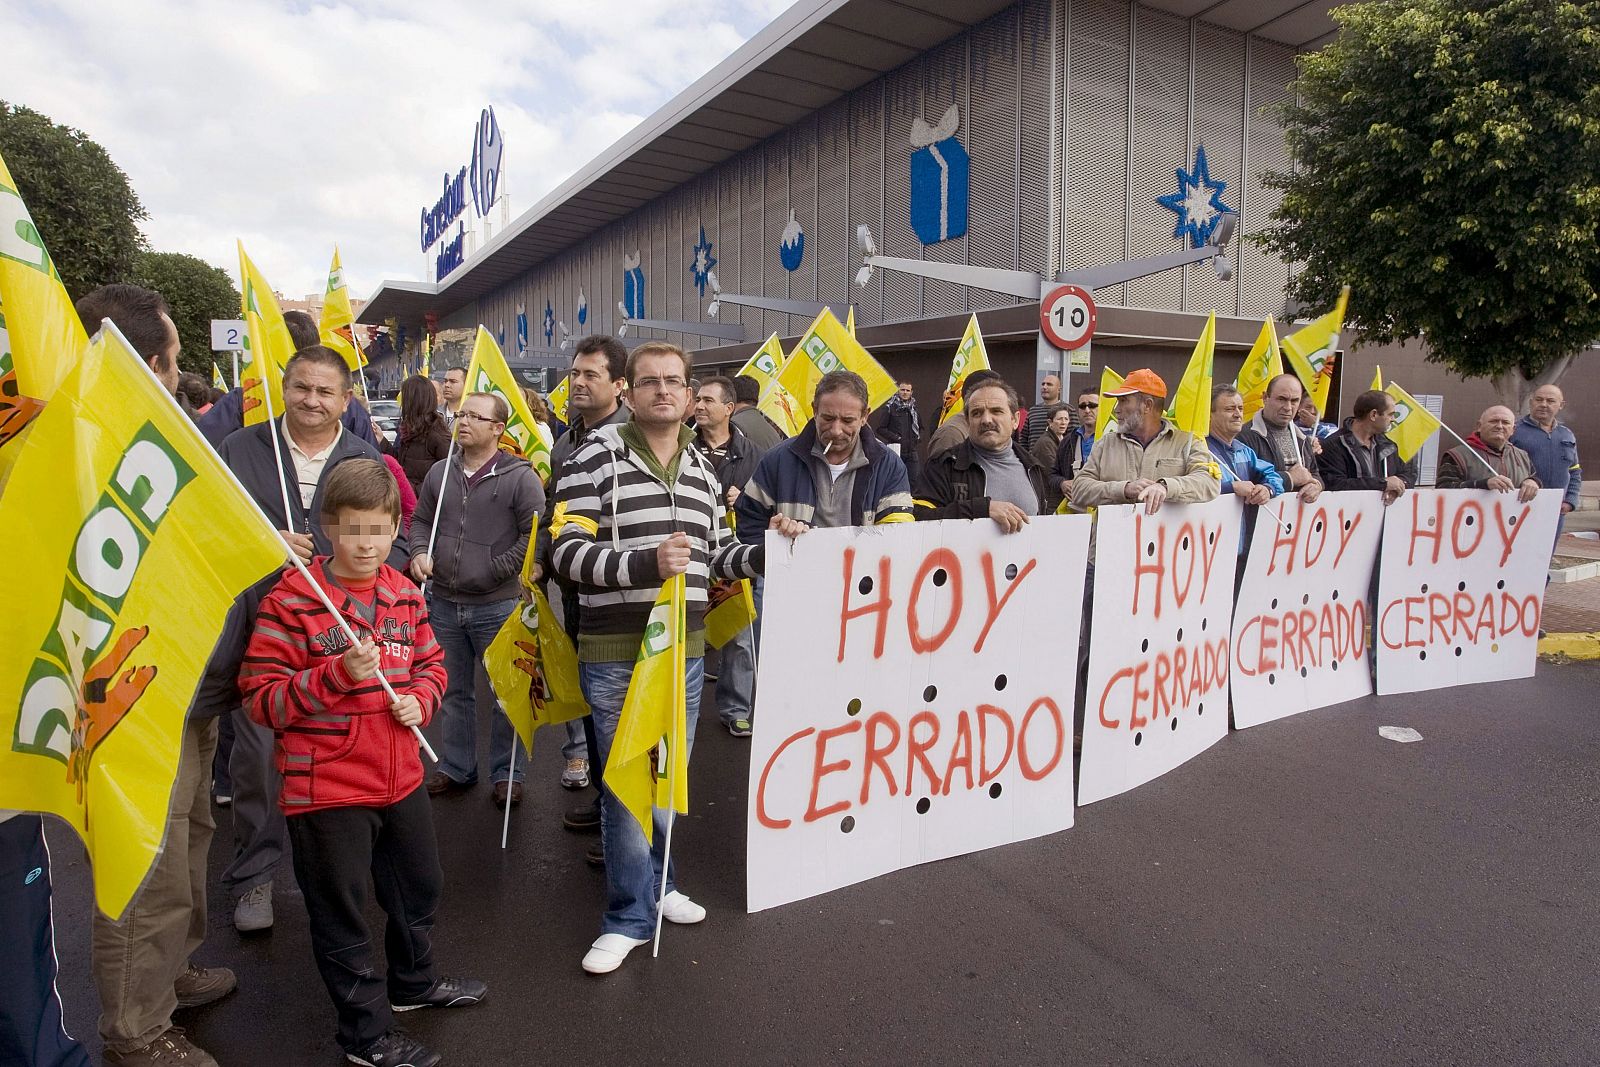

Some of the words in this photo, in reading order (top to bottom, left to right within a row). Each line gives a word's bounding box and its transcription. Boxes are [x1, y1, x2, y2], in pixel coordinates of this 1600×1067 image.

[421, 165, 467, 253] Carrefour
[227, 329, 238, 344] 2
[1054, 306, 1085, 328] 10
[1132, 514, 1222, 619] HOY
[1267, 498, 1362, 576] HOY
[1407, 492, 1530, 567] HOY
[837, 547, 1036, 663] HOY
[1236, 599, 1366, 676] CERRADO
[1380, 591, 1540, 650] CERRADO
[1099, 636, 1228, 730] CERRADO
[756, 696, 1064, 828] CERRADO
